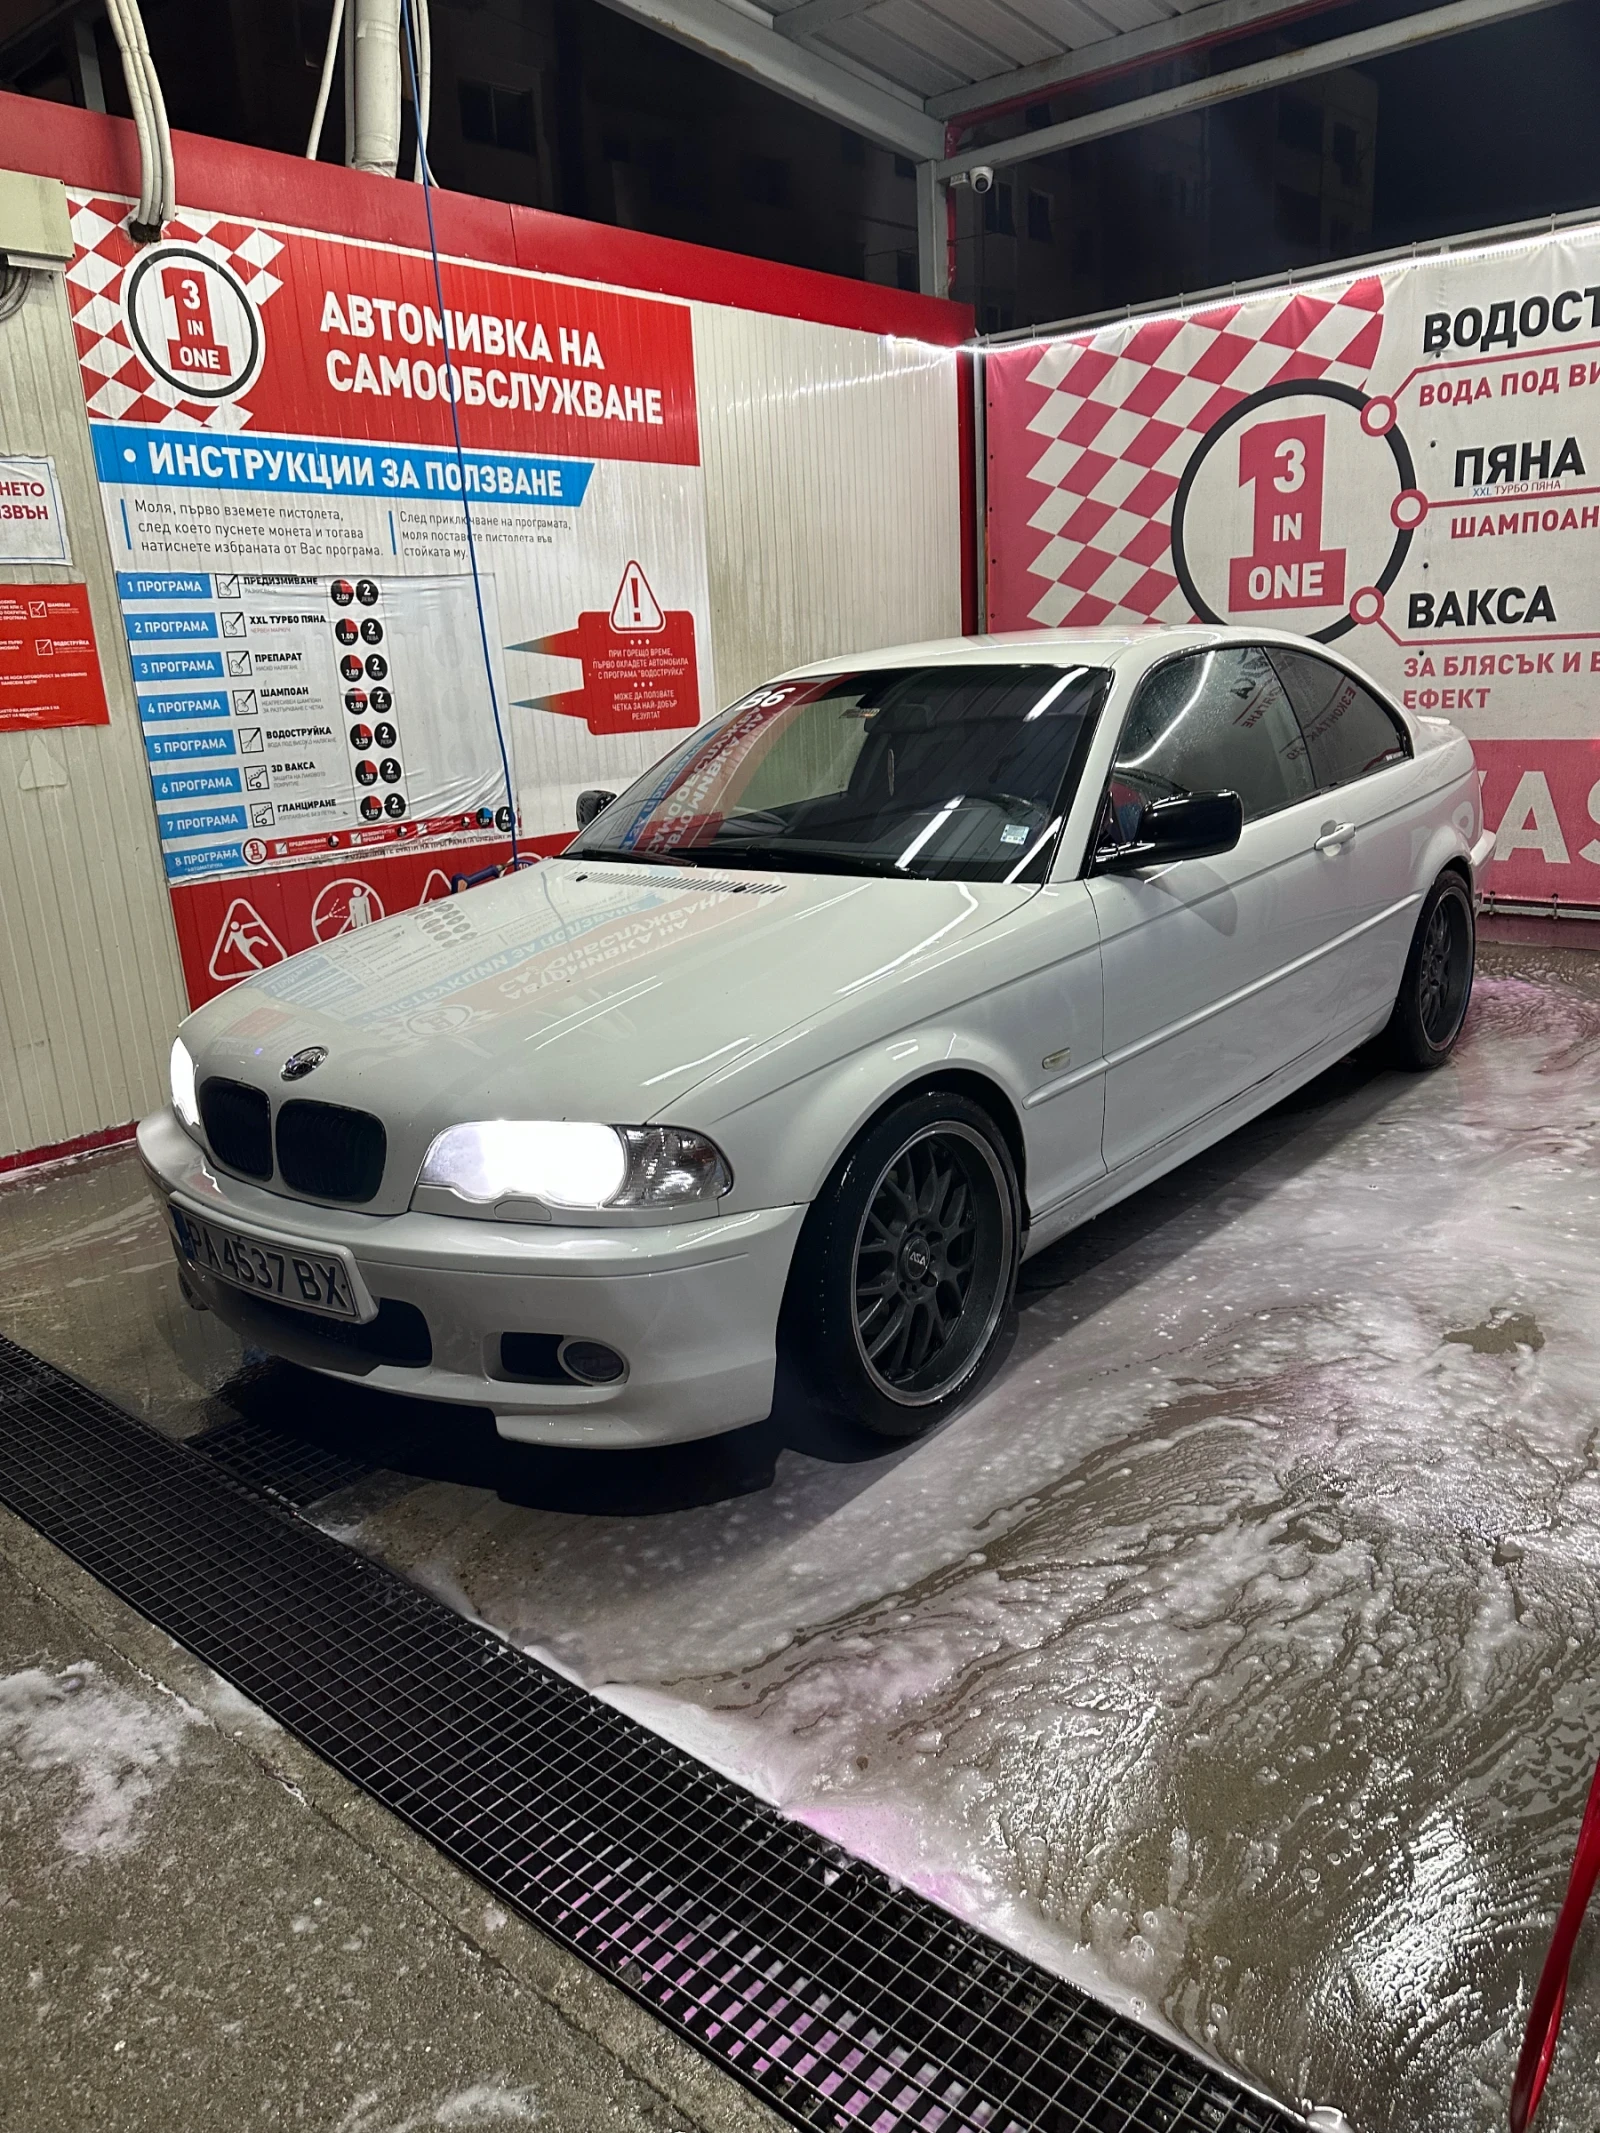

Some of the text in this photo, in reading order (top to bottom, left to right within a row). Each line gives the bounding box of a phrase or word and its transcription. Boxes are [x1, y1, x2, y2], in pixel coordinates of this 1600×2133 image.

[181, 279, 200, 309] 3
[187, 320, 205, 336] IN
[320, 291, 605, 370] АВТОМИВКА НА
[179, 346, 221, 370] ONE
[325, 350, 663, 425] САМООБСЛУЖВАНЕ
[1420, 377, 1492, 407] ВОДА
[1501, 366, 1560, 396] ПОД
[148, 441, 563, 497] ИНСТРУКЦИИ ЗА ПОЛЗВАНЕ
[1273, 438, 1306, 493] 3
[1454, 436, 1586, 487] ПЯНА
[1473, 479, 1561, 497] XXL ТУРБО ПЯНА
[0, 504, 48, 520] ЗВЪН
[135, 499, 344, 522] Моля, първо вземете пистолета,
[400, 511, 428, 525] След
[501, 519, 513, 527] на
[515, 519, 571, 531] програмата,
[1273, 512, 1302, 542] IN
[1451, 505, 1600, 539] ШАМПОАН
[138, 522, 364, 539] след което пуснете монета и тогава
[402, 531, 553, 544] моля поставте пистолета във
[142, 541, 384, 558] натиснете избраната от Вас програма.
[404, 545, 469, 561] стойката му.
[127, 580, 203, 592] 1 ПРОГРАМА
[243, 576, 318, 586] ПРЕДИЗМИВАНЕ
[1248, 561, 1325, 600] ONE
[362, 583, 371, 596] 2
[1408, 585, 1557, 629] ВАКСА
[134, 621, 209, 633] 2 ПРОГРАМА
[249, 614, 326, 625] XXL ТУРБО ПЯНА
[367, 622, 375, 635] 2
[255, 652, 302, 663] ПРЕПАРАТ
[608, 649, 622, 658] ПРИ
[623, 648, 649, 658] ГОРЕЩО
[140, 660, 215, 674] 3 ПРОГРАМА
[372, 658, 380, 671] 2
[593, 658, 689, 669] ПЪРВО ОХЛАДЕТЕ АВТОМОБИЛА
[1404, 657, 1436, 677] ЗА
[1443, 652, 1555, 677] БЛЯСЪК
[1562, 652, 1581, 673] И
[598, 671, 602, 679] С
[604, 670, 637, 679] ПРОГРАМА
[260, 687, 309, 698] ШАМПОАН
[376, 691, 384, 703] 2
[614, 690, 674, 701] МОЖЕ ДА ПОЛЗВАТЕ
[1403, 688, 1491, 709] ЕФЕКТ
[147, 699, 221, 714] 4 ПРОГРАМА
[612, 702, 632, 711] ЧЕТКА
[633, 702, 641, 710] ЗА
[632, 711, 660, 720] РЕЗУЛТАТ
[266, 726, 332, 740] ВОДОСТРУЙКА
[381, 726, 389, 739] 2
[154, 738, 227, 754] 5 ПРОГРАМА
[271, 761, 316, 773] 3D ВАКСА
[386, 761, 394, 774] 2
[161, 776, 233, 794] 6 ПРОГРАМА
[277, 798, 337, 813] ГЛАНЦИРАНЕ
[391, 796, 399, 809] 2
[167, 813, 239, 832] 7 ПРОГРАМА
[502, 809, 509, 821] 4
[174, 848, 239, 867] 8 ПРОГРАМА
[224, 1237, 286, 1294] 4537
